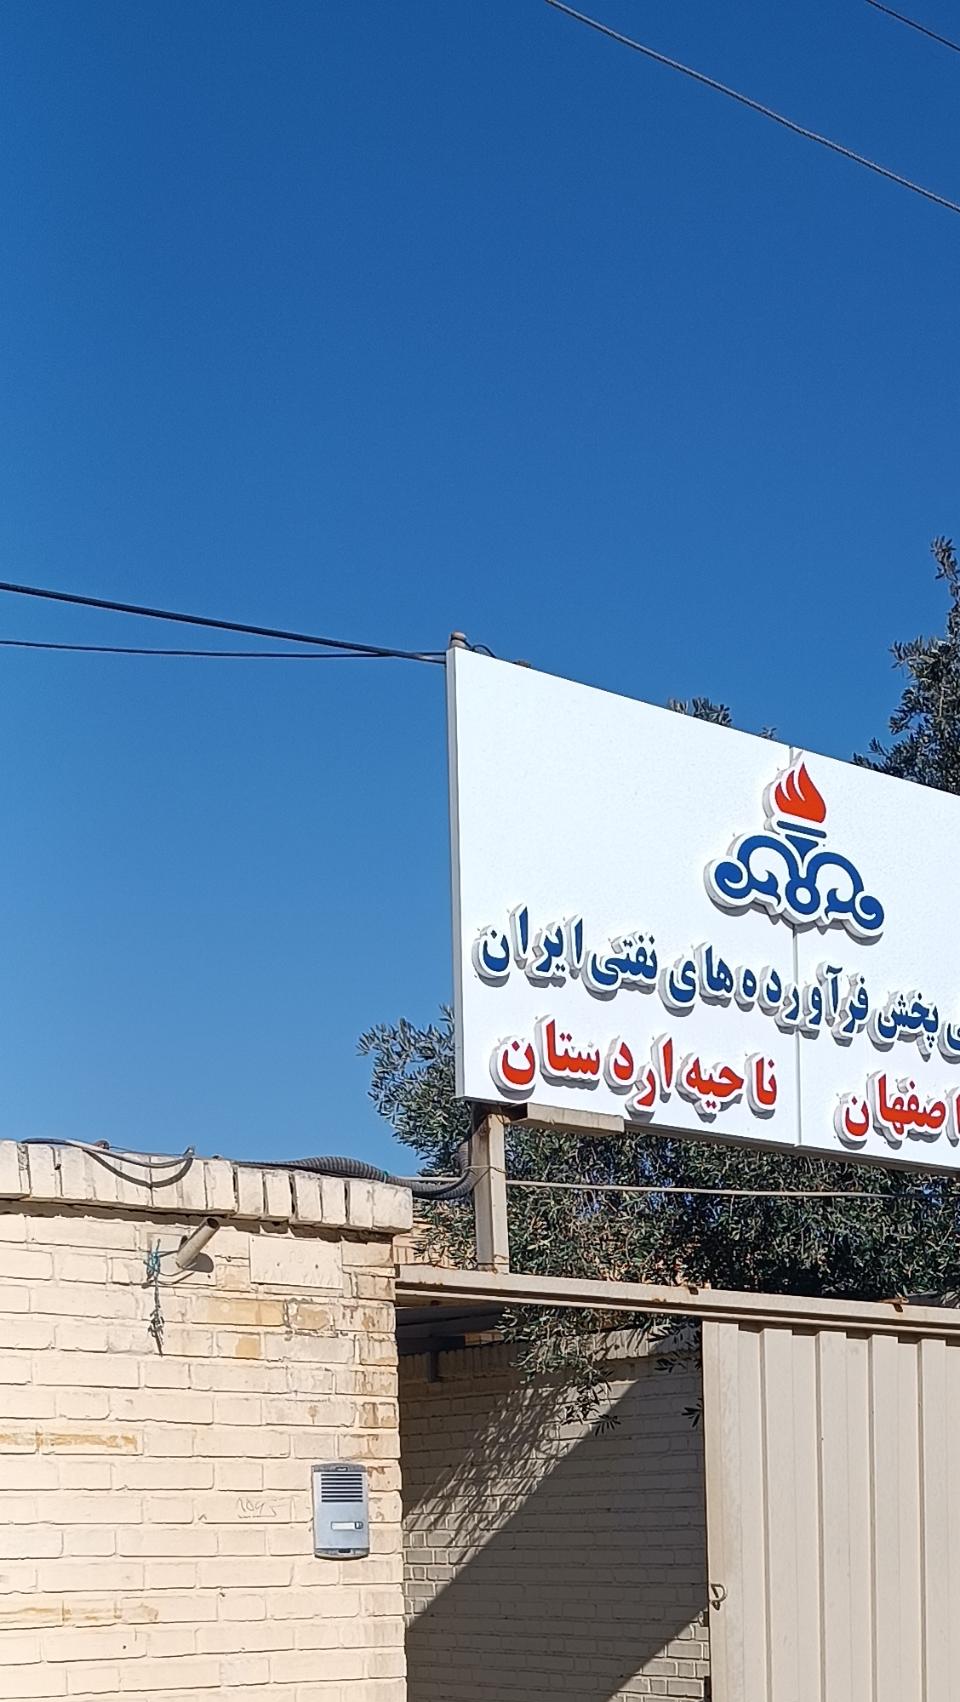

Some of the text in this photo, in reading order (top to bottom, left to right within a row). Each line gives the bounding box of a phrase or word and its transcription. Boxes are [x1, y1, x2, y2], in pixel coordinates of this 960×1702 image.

[480, 903, 585, 975] ایران
[589, 933, 660, 988] نفتی
[876, 991, 941, 1050] پخش
[500, 1018, 780, 1111] ناحیه اردستان
